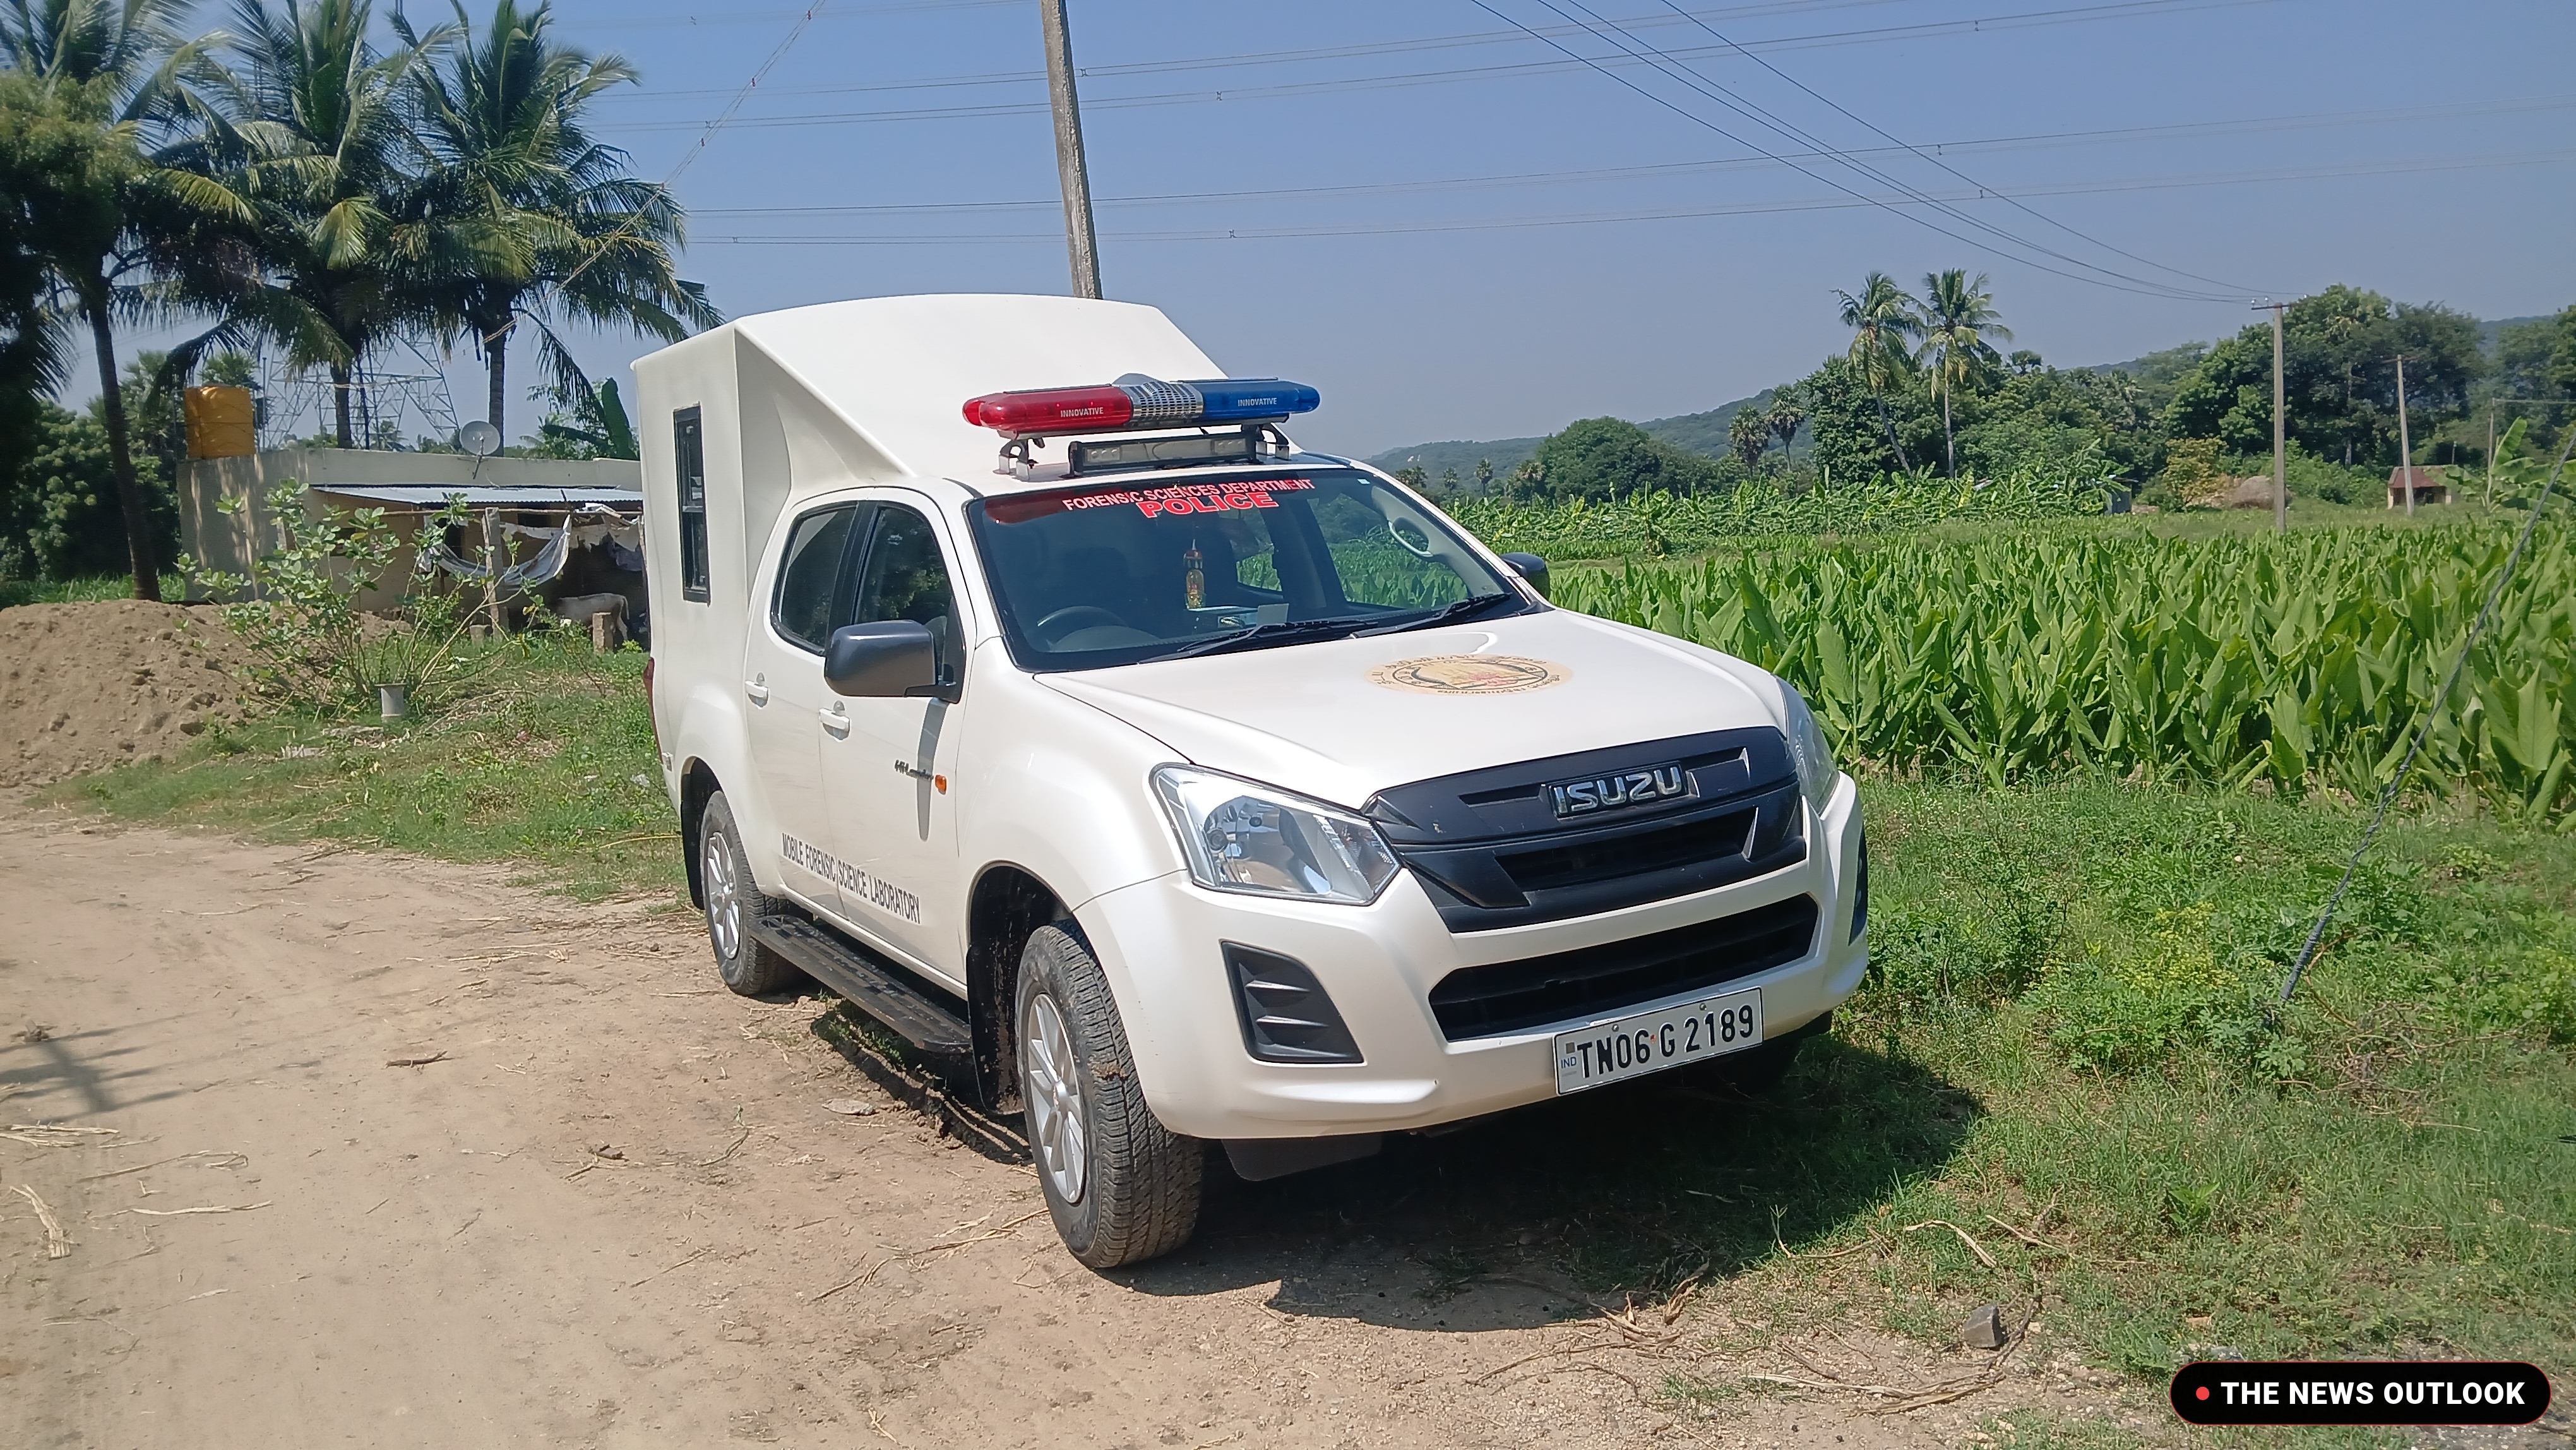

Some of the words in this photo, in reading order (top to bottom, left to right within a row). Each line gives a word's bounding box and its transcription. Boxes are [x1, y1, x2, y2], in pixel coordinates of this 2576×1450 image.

[1060, 406, 1104, 418] INNOVATIVE
[1237, 397, 1277, 407] INNOVATIVE
[1063, 491, 1143, 511] FORENSIC
[1143, 483, 1220, 501] SCIENCES
[1219, 479, 1315, 494] DEPARTMENT
[1136, 492, 1279, 518] POLICE
[1554, 767, 1683, 814] ISUZU
[782, 832, 804, 866] MOBILE
[805, 844, 836, 882] FORENSIC
[838, 860, 868, 898] SCIENCE
[868, 875, 921, 925] LABORATORY
[1577, 1028, 1650, 1079] TN06
[1683, 1004, 1753, 1053] 2189
[1560, 1056, 1577, 1069] IND
